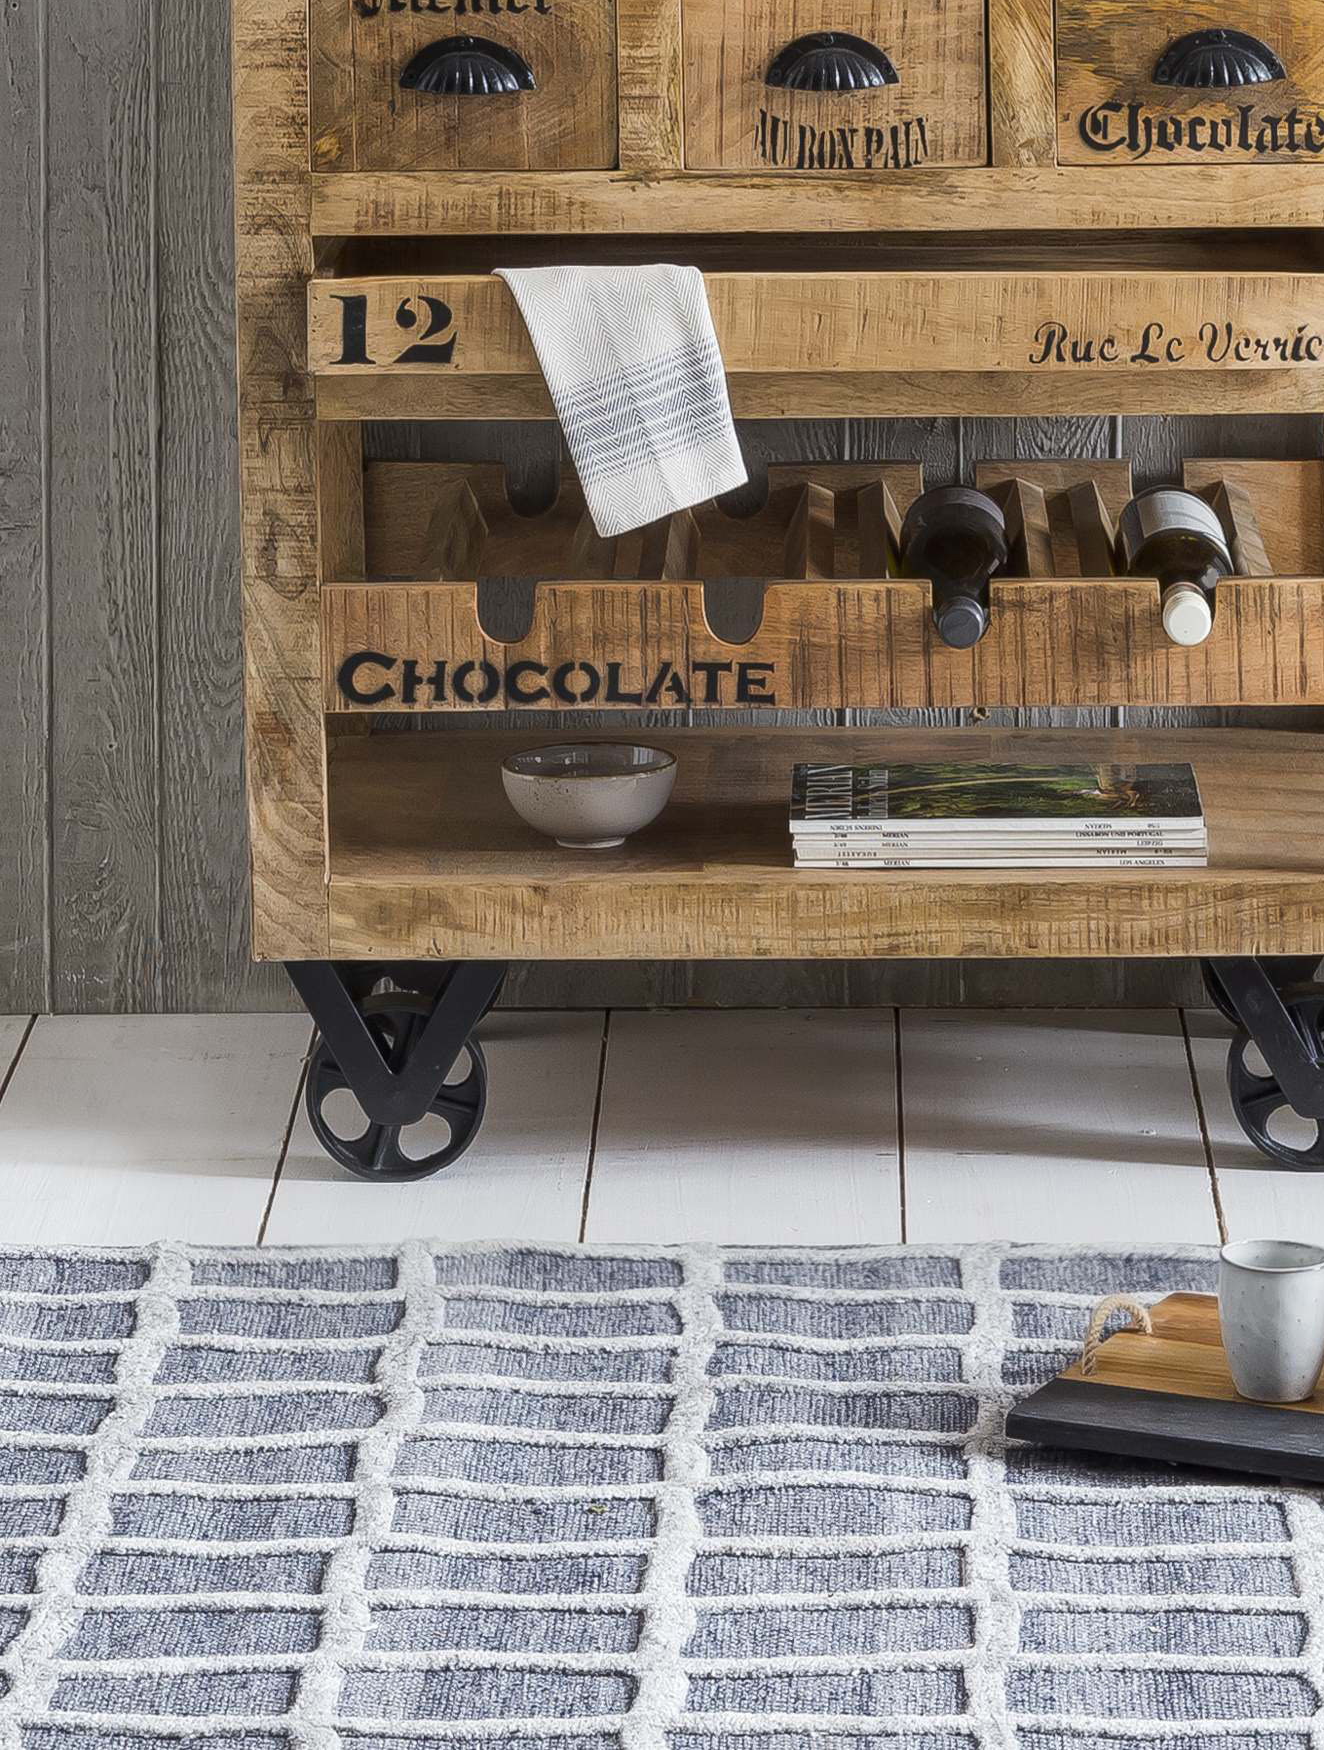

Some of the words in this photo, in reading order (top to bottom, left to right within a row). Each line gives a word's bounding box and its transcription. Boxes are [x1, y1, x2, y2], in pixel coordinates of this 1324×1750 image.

[328, 293, 458, 365] 12
[1029, 321, 1119, 365] Rue
[1130, 322, 1184, 364] Le
[337, 651, 777, 706] CHOCOLATE
